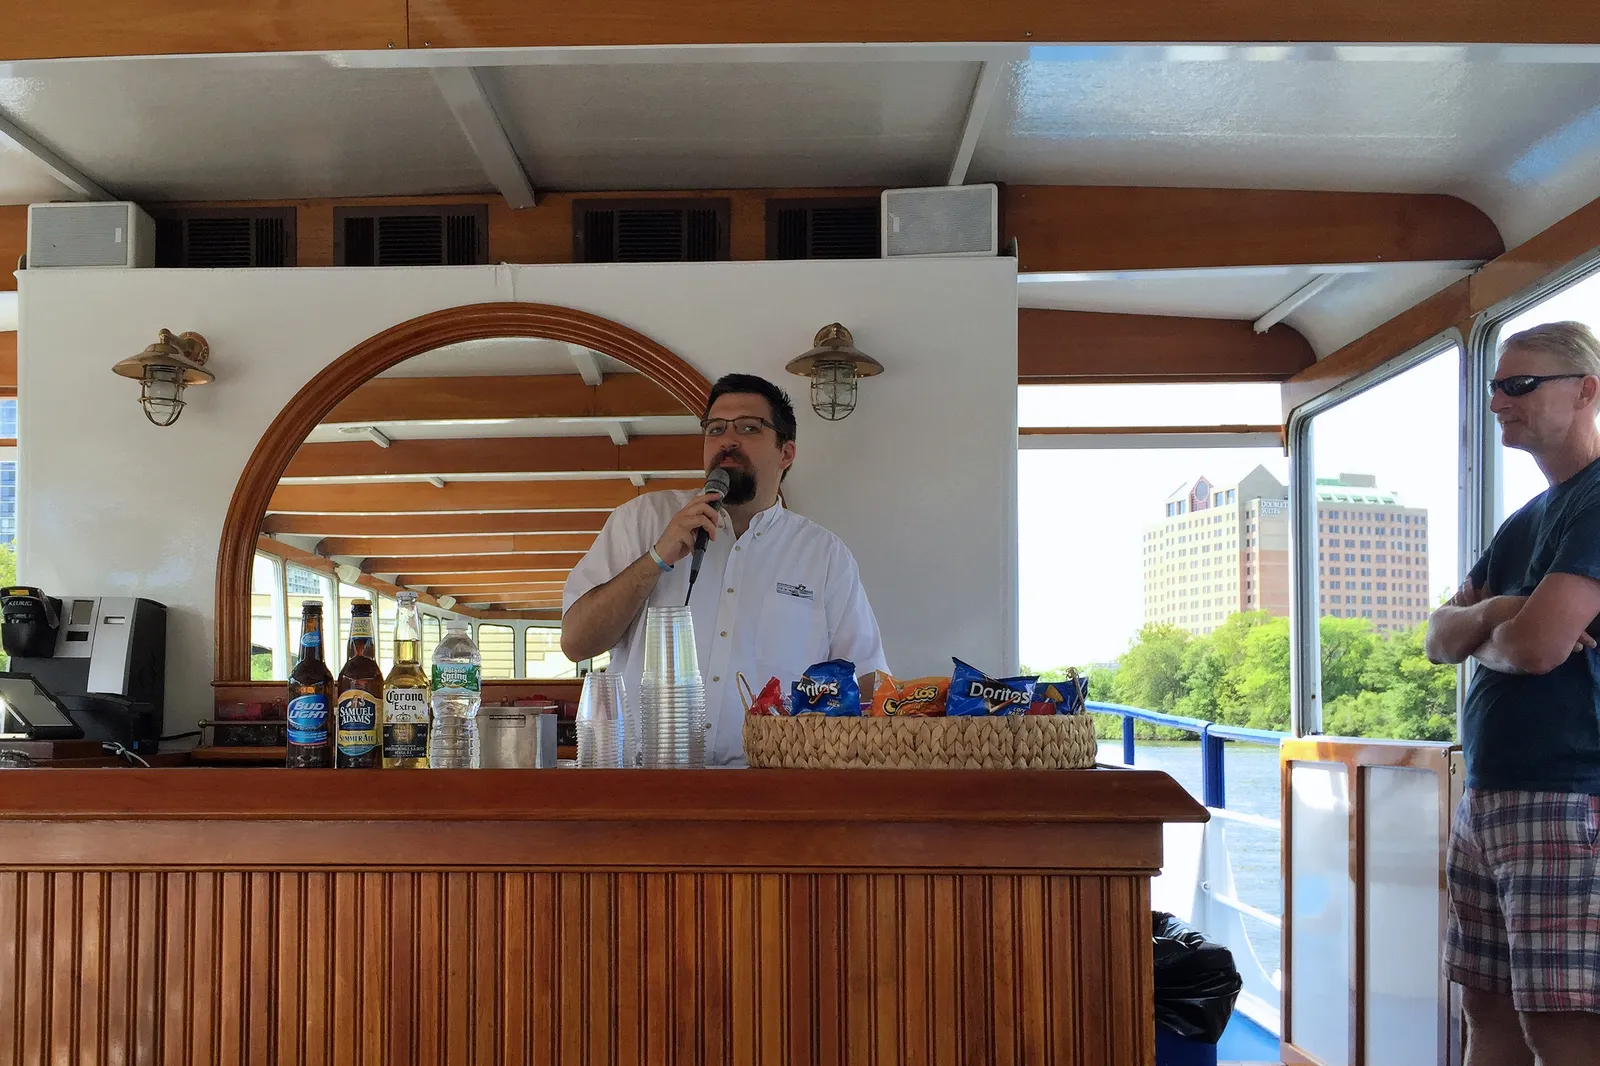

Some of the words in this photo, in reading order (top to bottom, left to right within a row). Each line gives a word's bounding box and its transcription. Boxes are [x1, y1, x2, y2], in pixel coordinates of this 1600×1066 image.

[441, 672, 468, 684] Spring
[386, 690, 425, 705] Corona
[969, 682, 1031, 705] Doritos
[294, 702, 325, 711] BUD
[340, 706, 374, 717] SAMUEL
[394, 702, 417, 711] Extra
[289, 710, 328, 719] LIGHT
[341, 715, 371, 725] ADAMS
